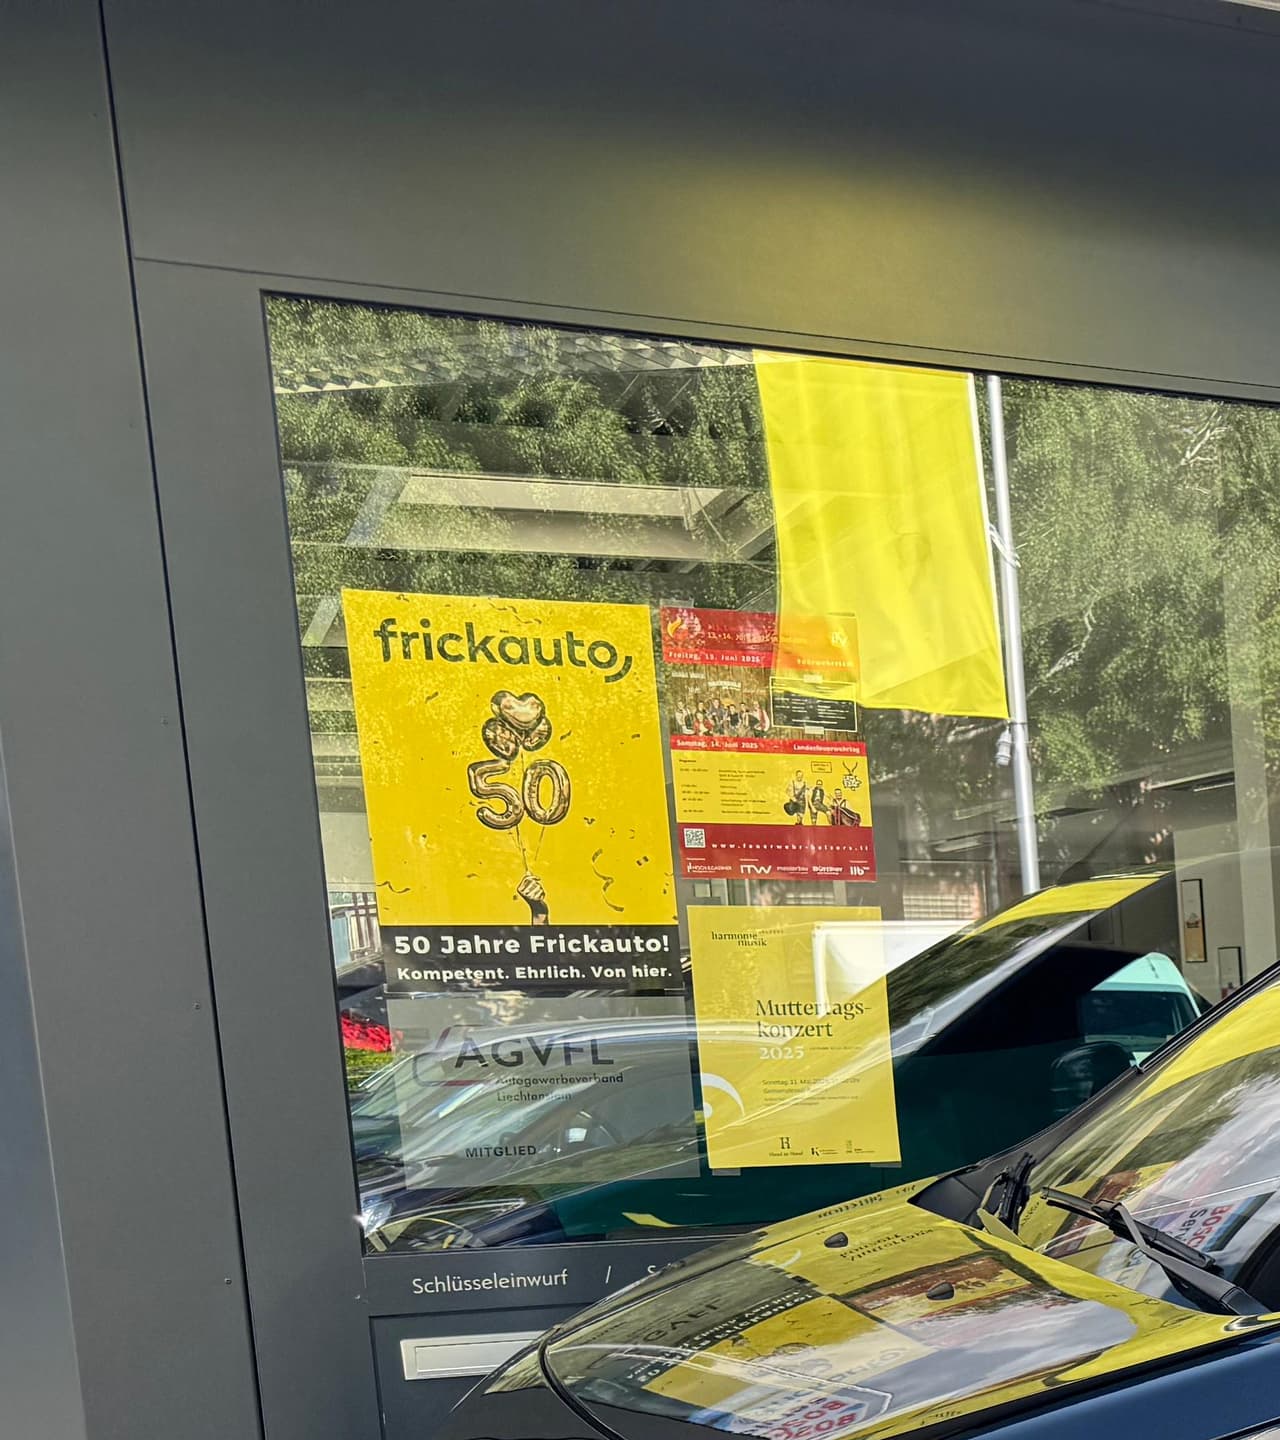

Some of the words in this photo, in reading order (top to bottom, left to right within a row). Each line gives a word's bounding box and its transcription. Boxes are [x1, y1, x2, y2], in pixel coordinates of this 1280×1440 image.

[467, 759, 572, 831] 50
[394, 935, 431, 954] 50
[440, 935, 521, 954] Jahre
[529, 933, 671, 954] Frickauto!
[397, 967, 510, 983] Kompetent.
[515, 965, 586, 979] Ehrlich.
[591, 966, 627, 979] Von
[631, 965, 673, 978] hier.
[758, 1020, 834, 1039] konzert
[454, 1035, 616, 1068] AGVFL
[759, 1046, 805, 1060] 2025
[464, 1144, 538, 1159] MITGLIED
[412, 1268, 569, 1294] Schlüsseleinwurf
